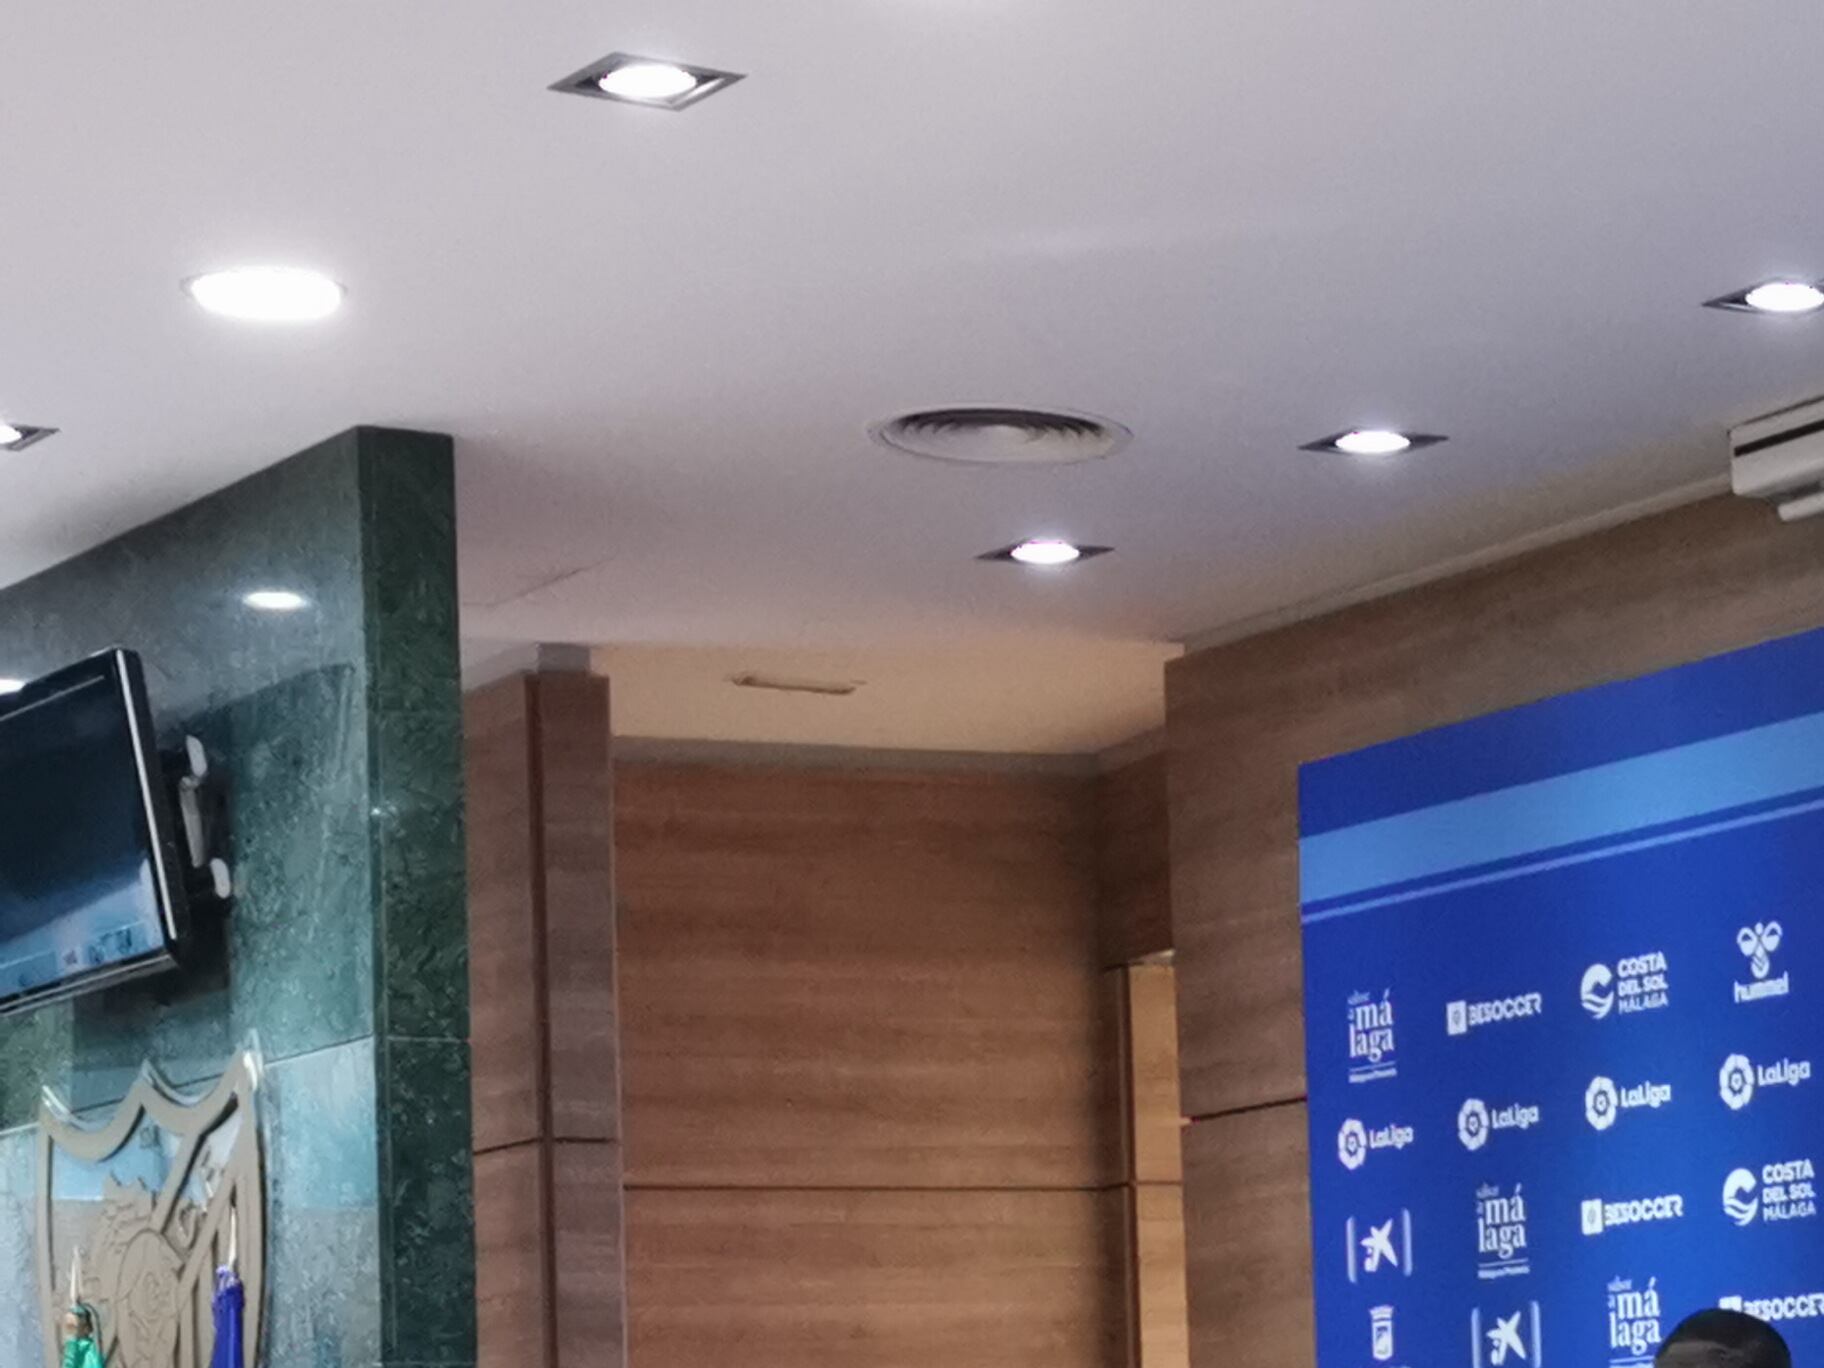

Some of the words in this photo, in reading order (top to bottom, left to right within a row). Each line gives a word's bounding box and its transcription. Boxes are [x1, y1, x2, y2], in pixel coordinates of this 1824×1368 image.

[1734, 971, 1789, 1003] hummel
[1757, 1058, 1811, 1087] LaLiga
[1620, 1081, 1671, 1108] LaLiga
[1491, 1103, 1539, 1129] LaLiga
[1368, 1124, 1414, 1149] LaLiga
[1762, 1159, 1815, 1185] COSTA
[1609, 1312, 1662, 1356] laga
